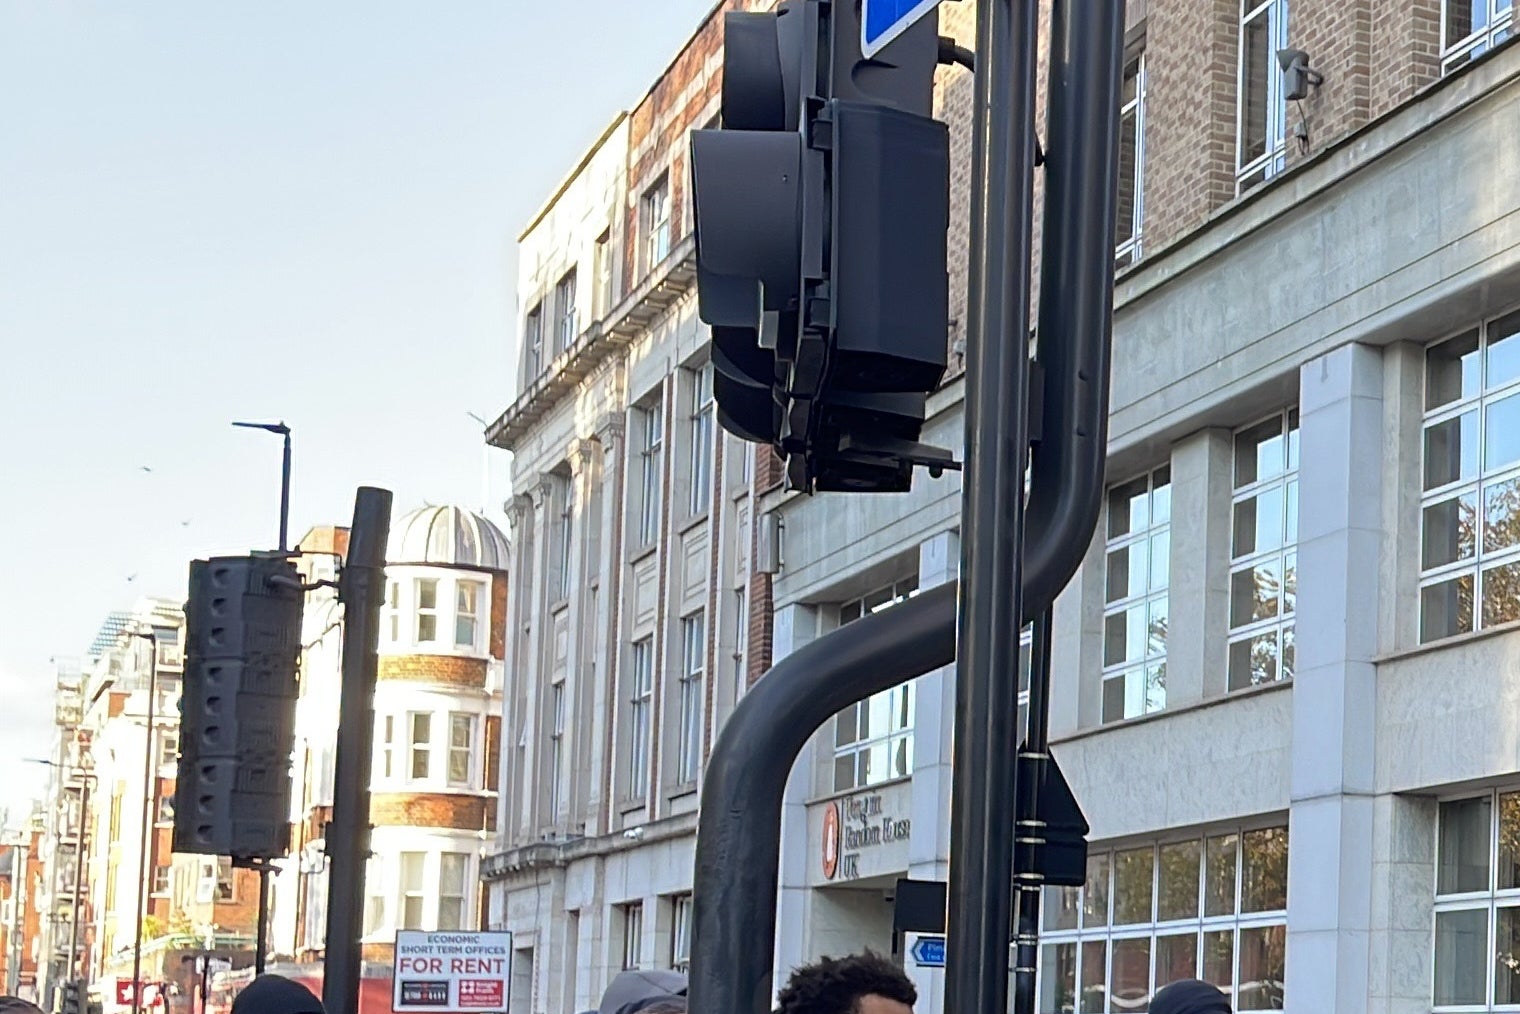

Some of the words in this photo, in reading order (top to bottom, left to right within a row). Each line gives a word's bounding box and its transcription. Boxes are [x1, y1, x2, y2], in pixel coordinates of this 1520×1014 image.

[428, 935, 480, 943] ECONOMIC
[401, 946, 433, 954] SHORT
[437, 946, 463, 954] TERM
[465, 946, 506, 954] OFFICES
[400, 958, 442, 973] FOR
[451, 958, 505, 973] RENT
